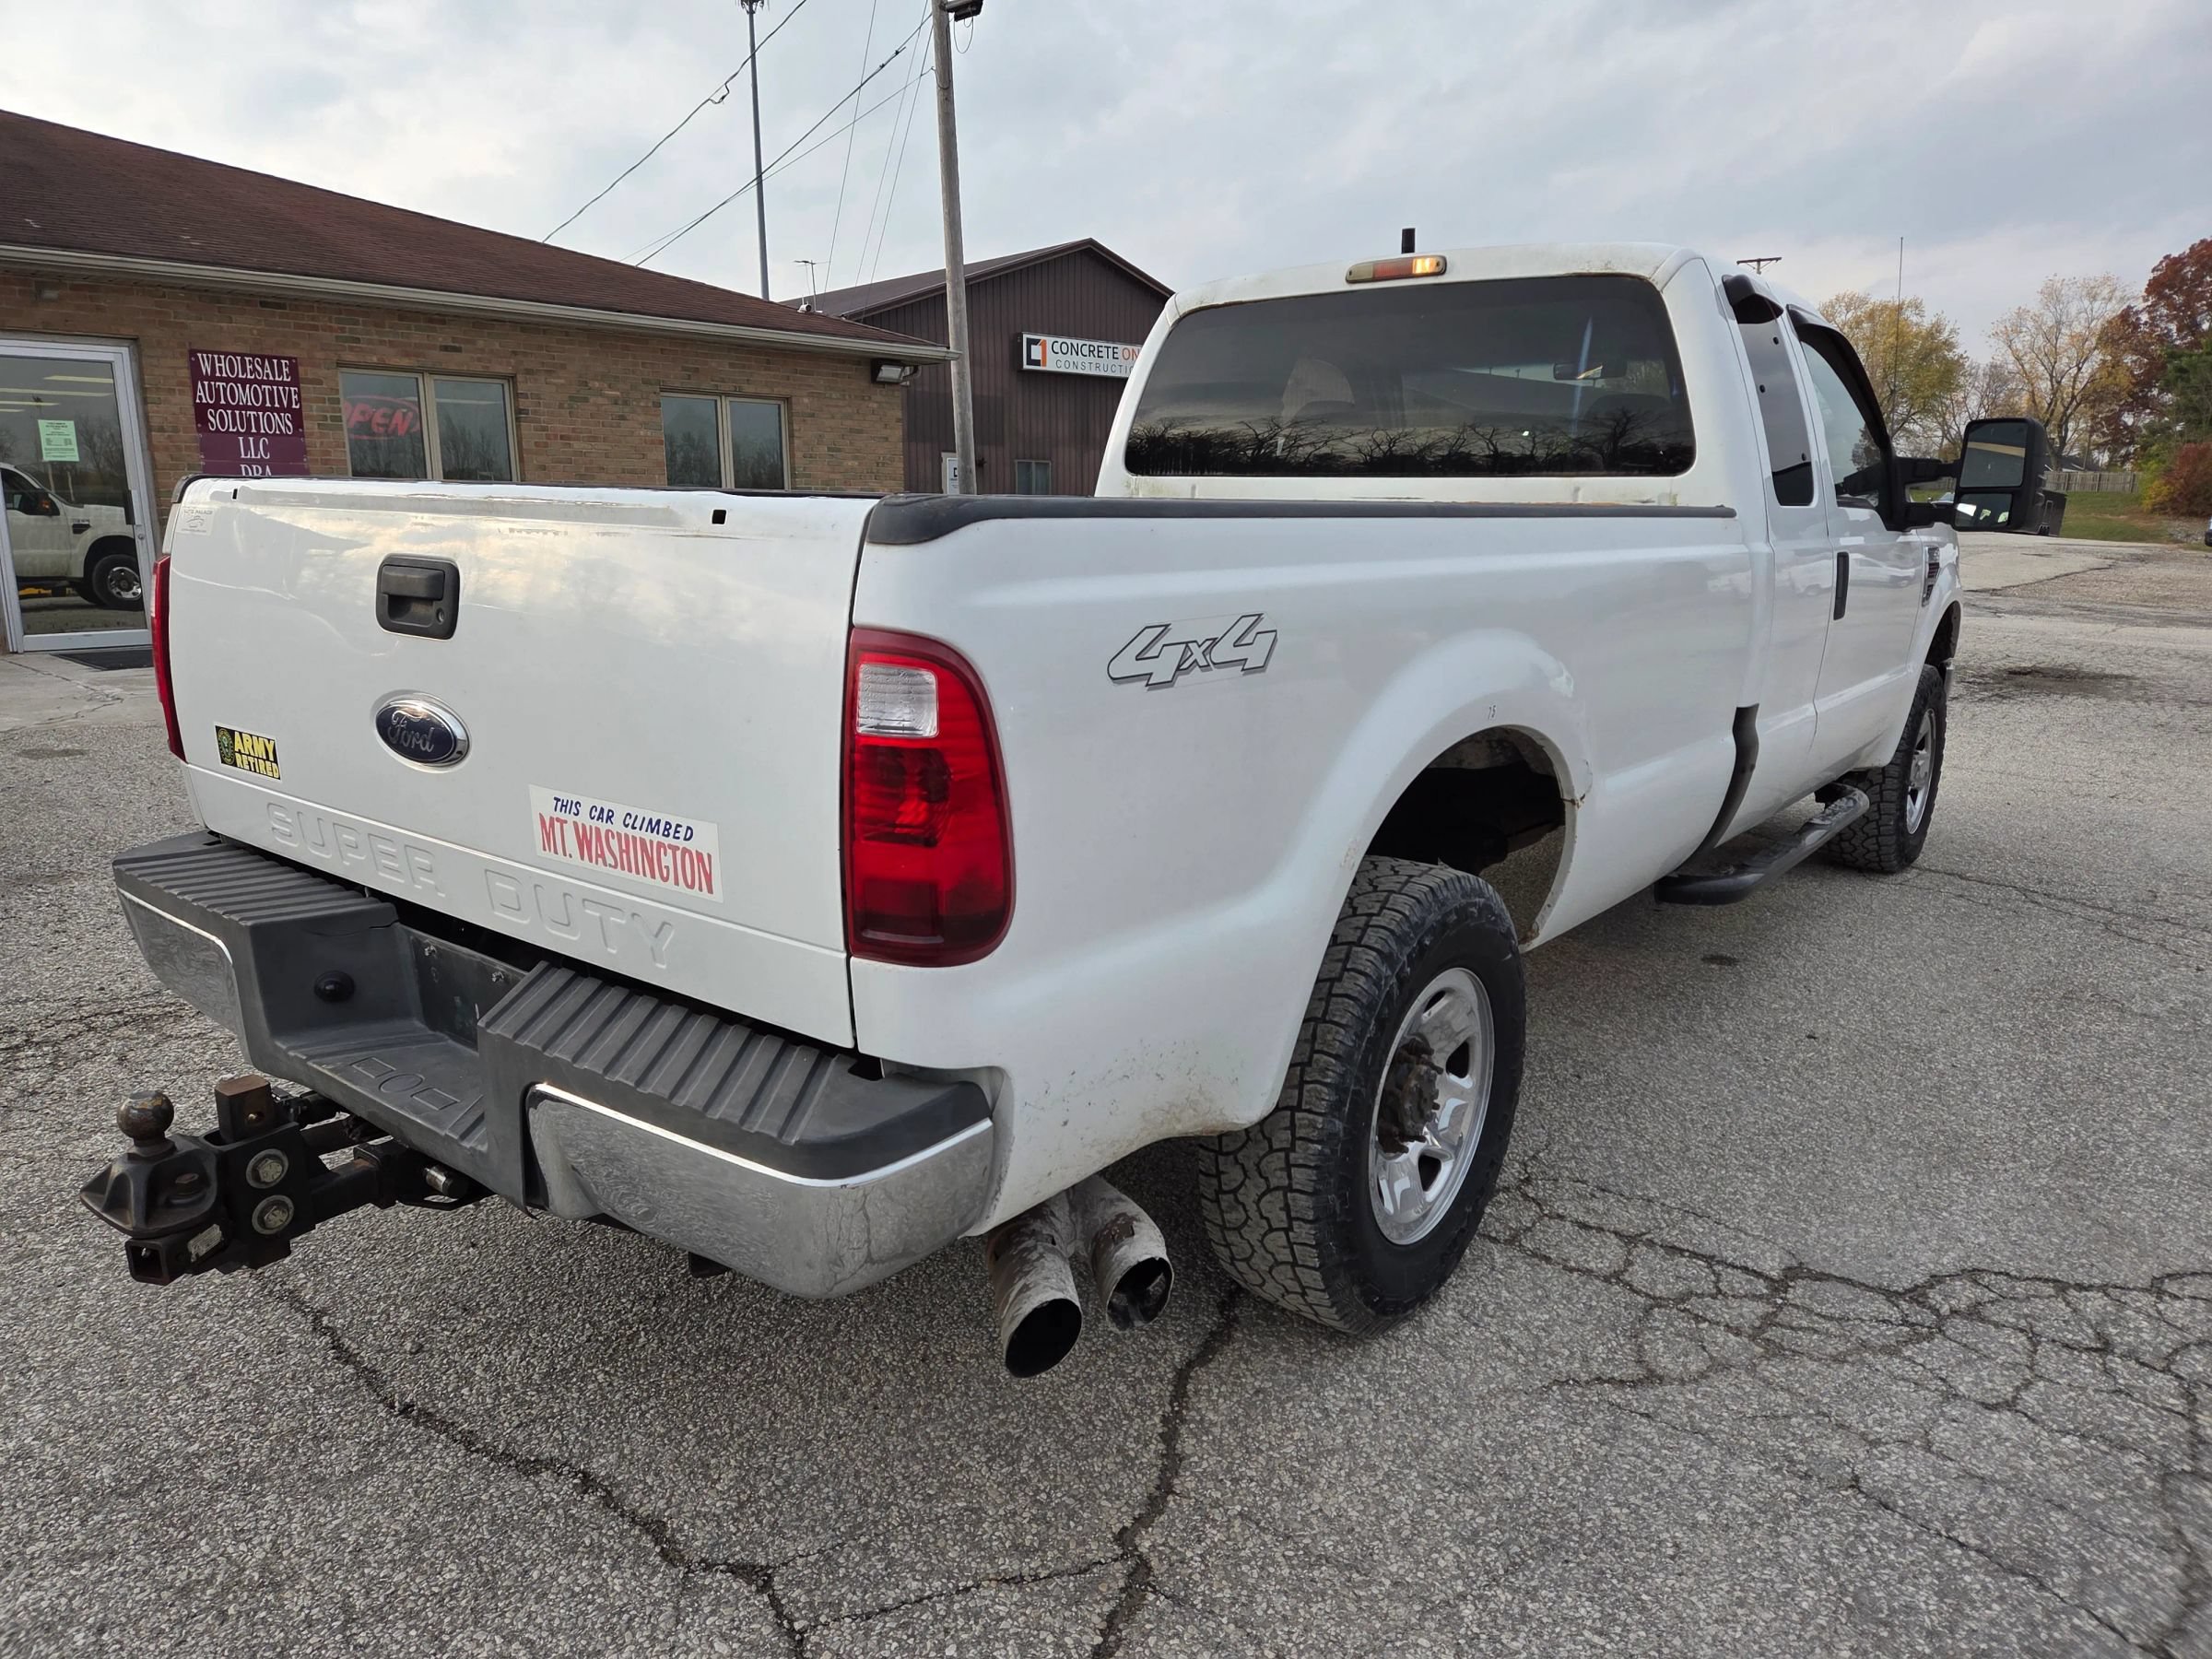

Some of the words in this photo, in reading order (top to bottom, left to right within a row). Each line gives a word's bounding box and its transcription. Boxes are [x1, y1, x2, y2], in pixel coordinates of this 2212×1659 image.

[1052, 340, 1119, 359] CONCRETE
[196, 353, 291, 382] WHOLESALE
[195, 381, 300, 408] AUTOMOTIVE
[207, 408, 293, 434] SOLUTIONS
[238, 437, 270, 459] LLC
[1107, 613, 1278, 692] 4x4
[234, 731, 275, 761] ARMY
[387, 710, 435, 753] Ford
[234, 752, 280, 779] RETIRED
[553, 796, 582, 817] THIS
[589, 805, 615, 825] CAR
[622, 812, 694, 841] CLIMBED
[538, 812, 573, 859] MT.
[572, 820, 714, 895] WASHINGTON
[266, 803, 447, 898] SUPER
[484, 869, 675, 969] DUTY
